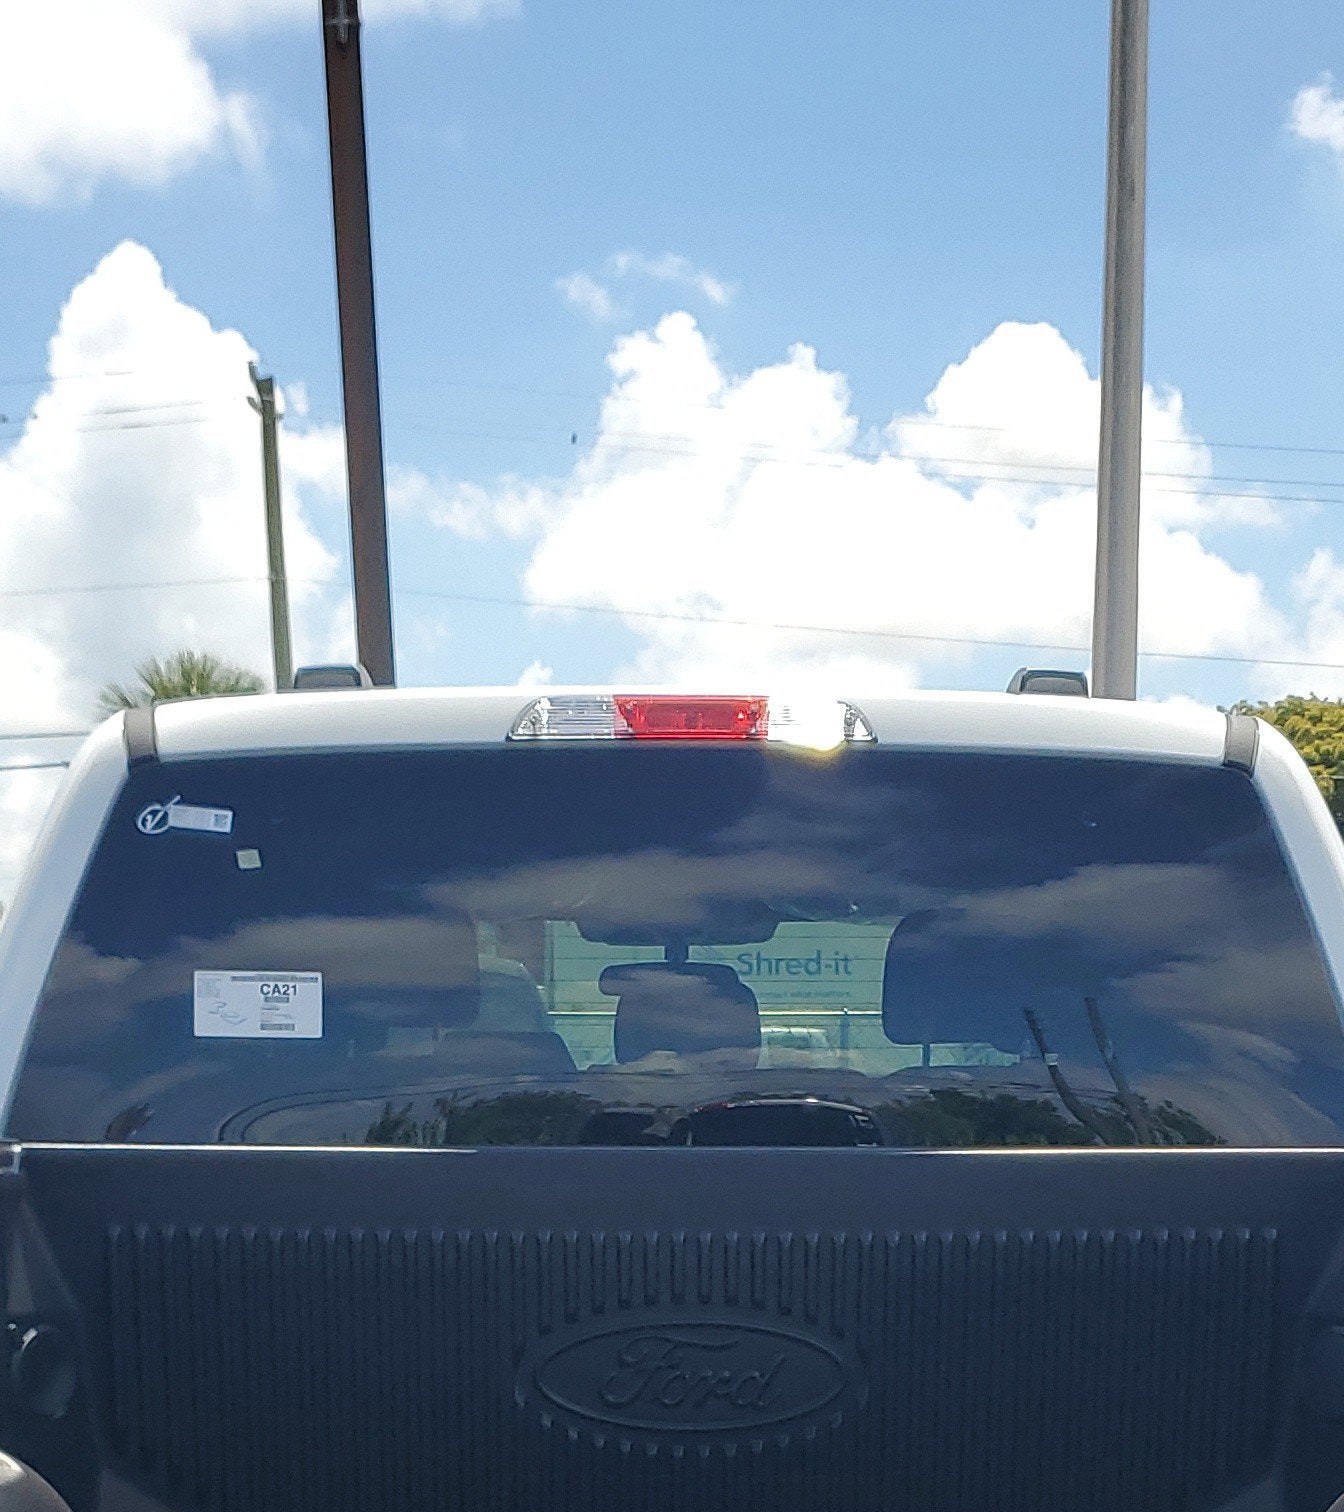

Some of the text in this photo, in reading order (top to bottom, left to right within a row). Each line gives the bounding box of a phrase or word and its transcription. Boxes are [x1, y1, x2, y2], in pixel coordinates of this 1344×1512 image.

[736, 949, 852, 976] Shred-it
[259, 983, 298, 997] CA21
[599, 1335, 787, 1408] Ford
